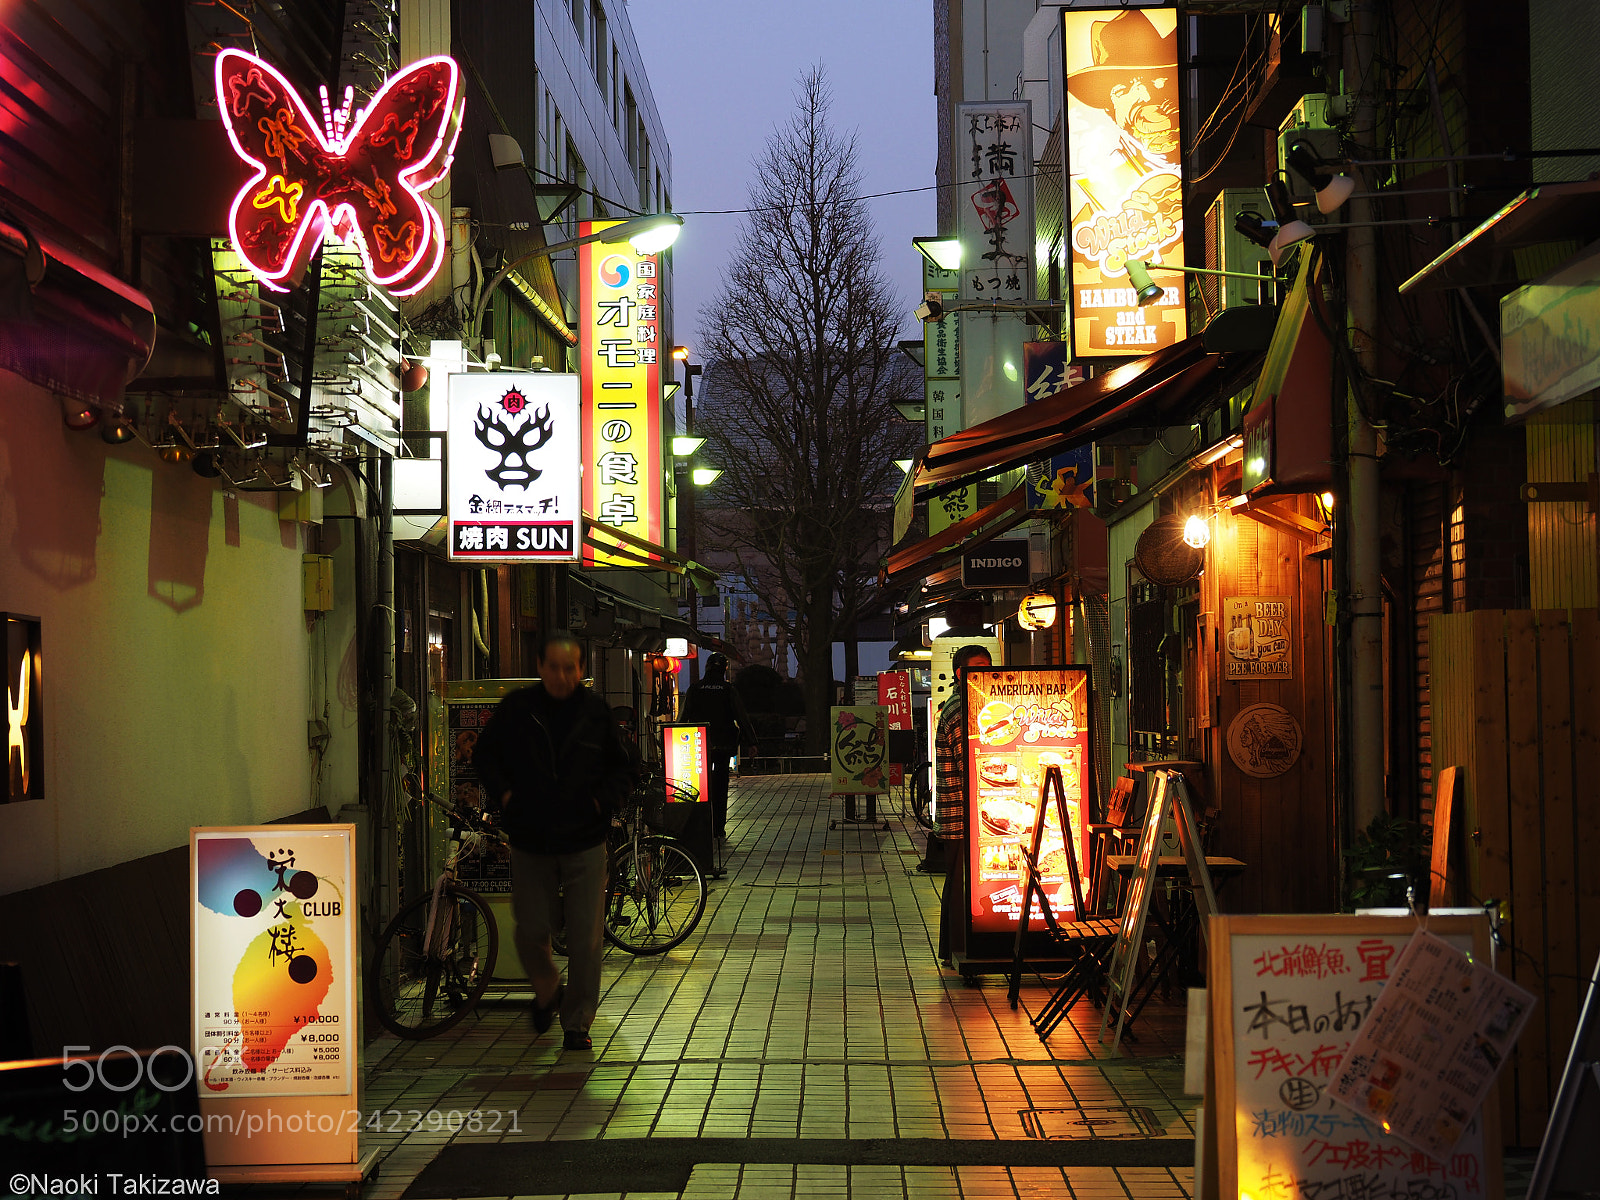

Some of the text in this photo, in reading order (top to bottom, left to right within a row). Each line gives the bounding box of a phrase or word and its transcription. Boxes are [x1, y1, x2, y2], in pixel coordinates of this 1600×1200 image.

[1077, 210, 1149, 256] Wild
[1105, 213, 1177, 272] Stock
[972, 275, 1021, 292] もつ焼
[1080, 287, 1180, 308] HAMBUER
[1116, 307, 1146, 326] and
[1105, 326, 1157, 345] STEAK
[597, 296, 638, 526] オモニの食卓
[459, 526, 568, 550] 焼肉 SUN
[970, 558, 1023, 569] INDIGO
[1254, 602, 1285, 619] BEER
[1257, 619, 1283, 637] DAY
[1257, 640, 1286, 659] you can
[1228, 660, 1289, 675] PEE FOREVER
[990, 683, 1067, 696] AMERICAN BAR
[1013, 703, 1064, 726] Wild
[1022, 719, 1078, 743] Stock
[303, 902, 341, 917] CLUB
[293, 1015, 339, 1024] ¥10,000
[301, 1034, 340, 1042] ¥8,000
